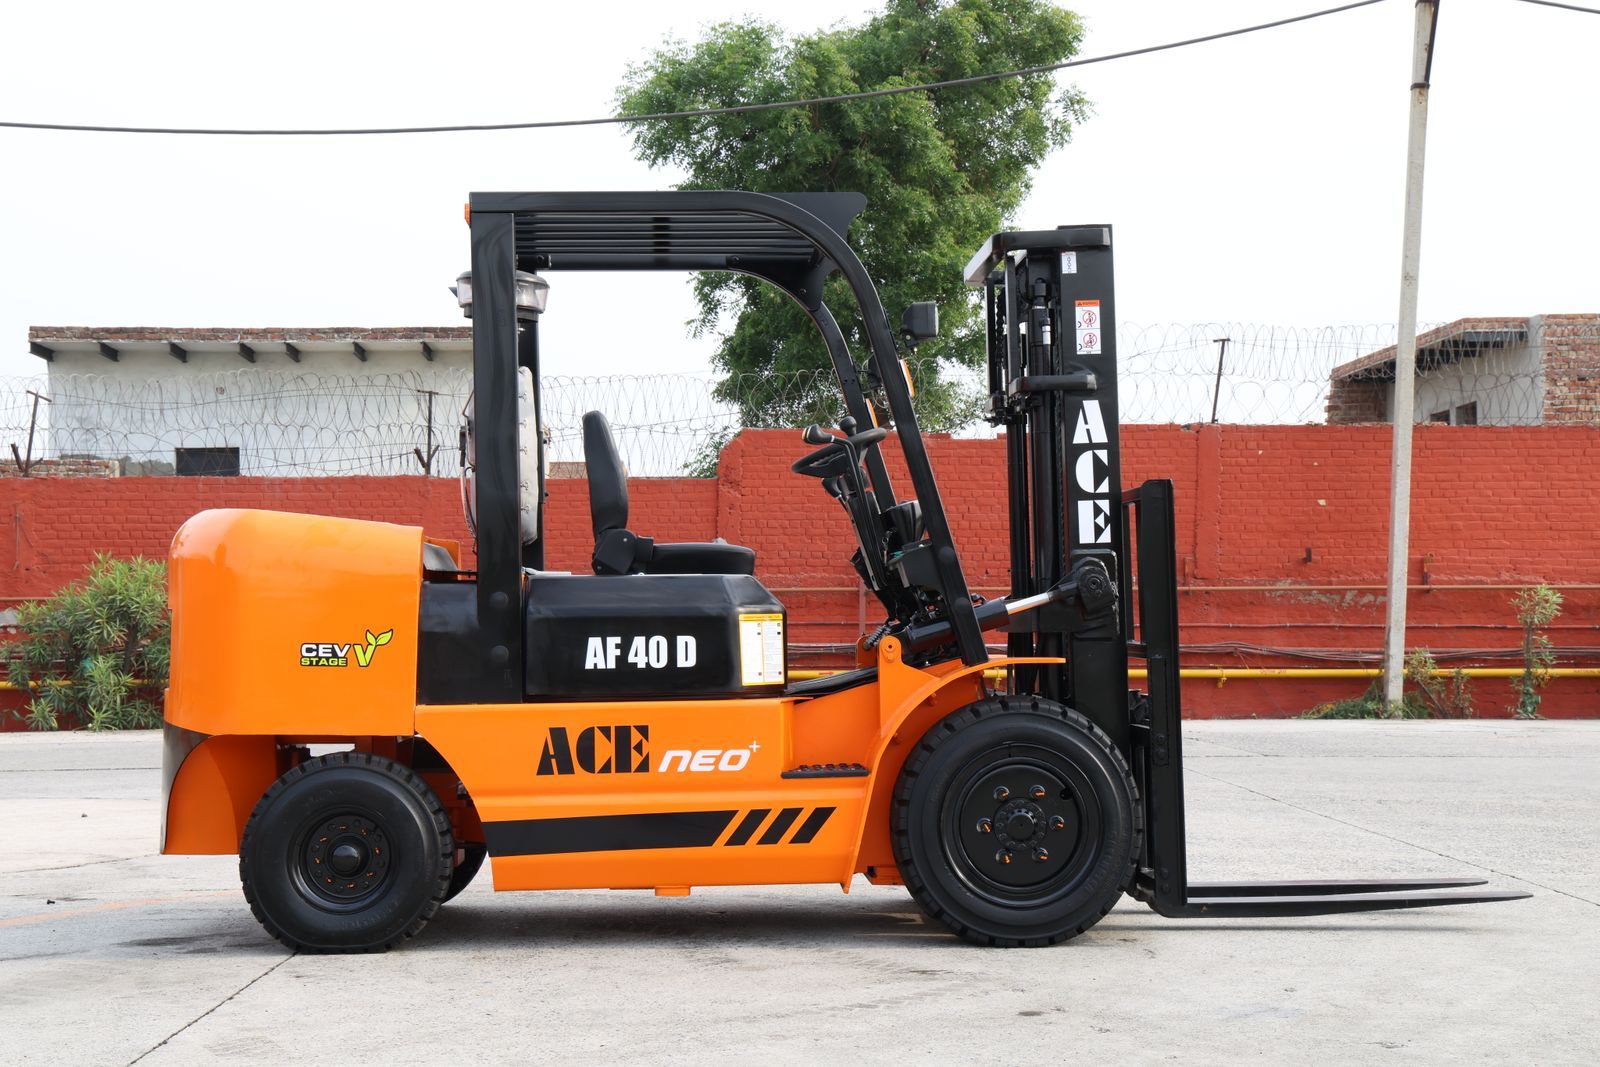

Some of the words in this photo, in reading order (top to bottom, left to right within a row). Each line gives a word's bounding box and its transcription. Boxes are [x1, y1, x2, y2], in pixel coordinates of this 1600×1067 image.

[1073, 400, 1111, 544] ACE
[301, 643, 350, 657] CEV
[301, 657, 347, 666] STAGE
[584, 636, 622, 670] AF
[627, 635, 668, 669] 40
[676, 635, 697, 668] D
[536, 725, 650, 776] ACE
